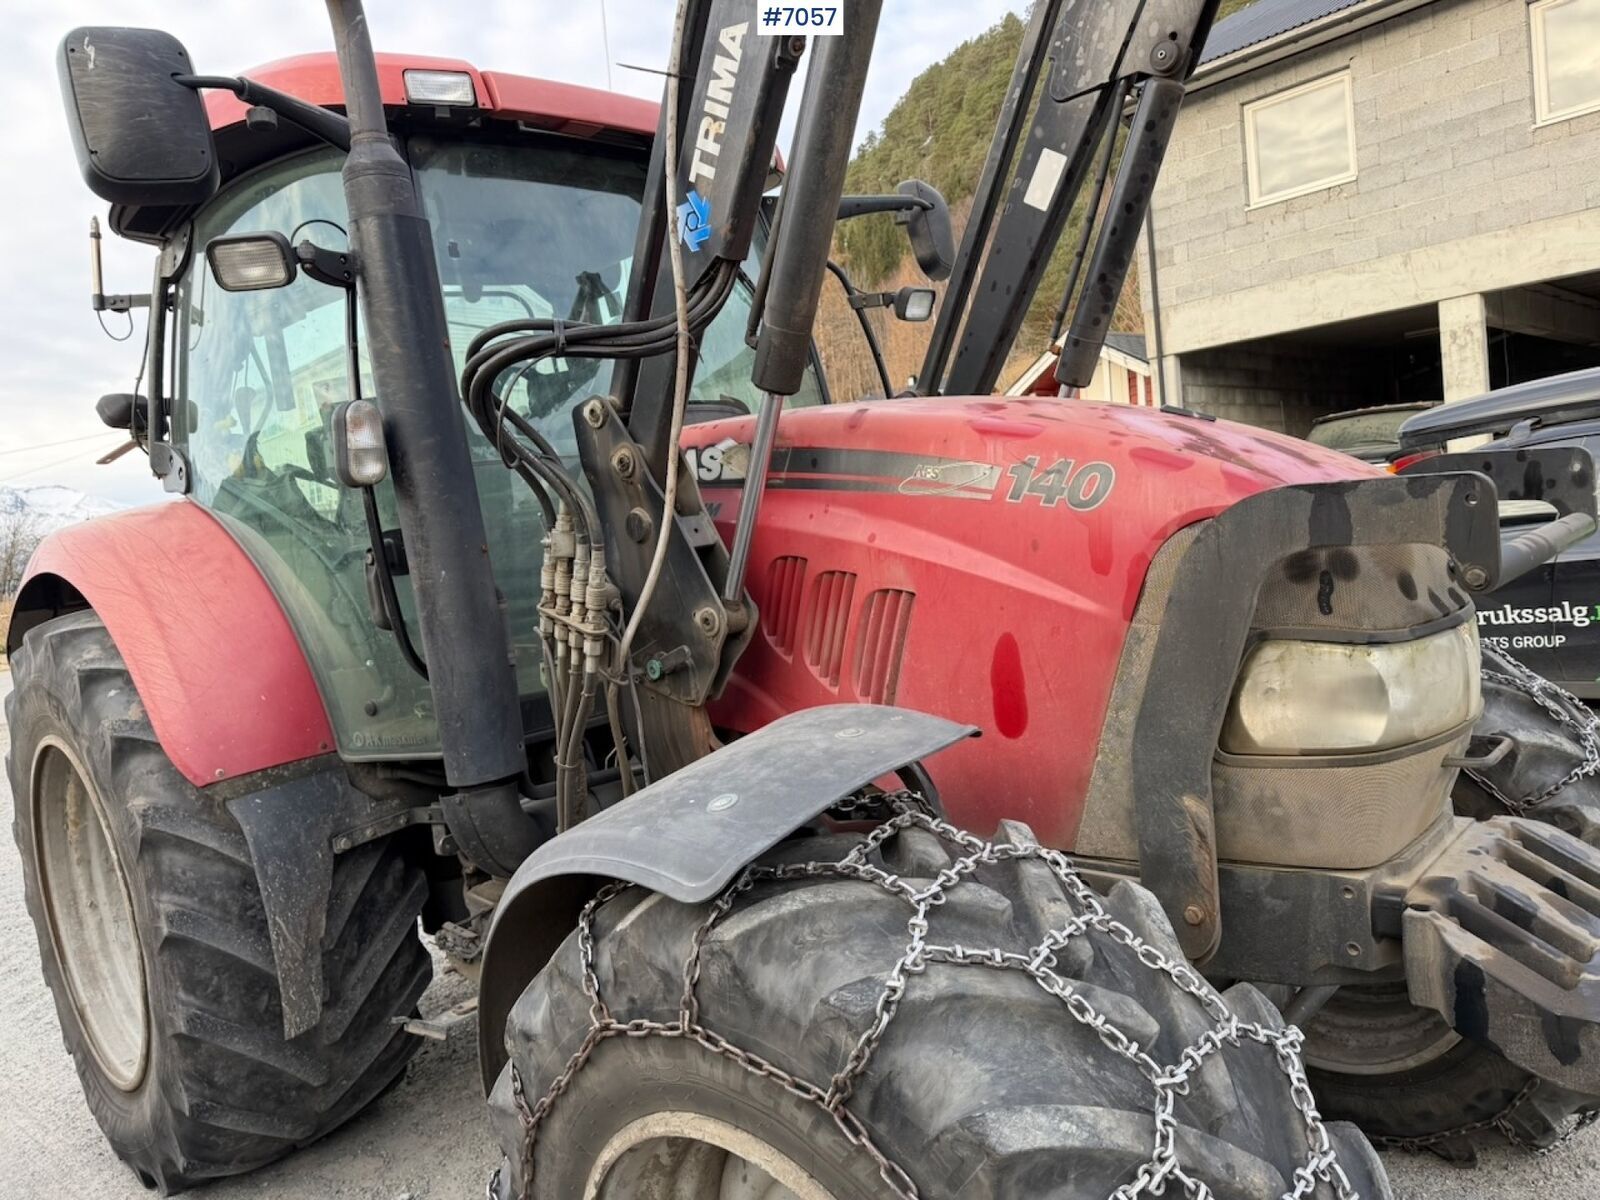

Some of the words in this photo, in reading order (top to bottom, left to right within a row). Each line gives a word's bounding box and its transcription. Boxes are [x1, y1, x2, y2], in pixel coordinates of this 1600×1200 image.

[688, 21, 749, 184] TRIMA
[912, 463, 941, 481] AFS
[1005, 455, 1116, 512] 140
[1512, 635, 1566, 649] GROUP
